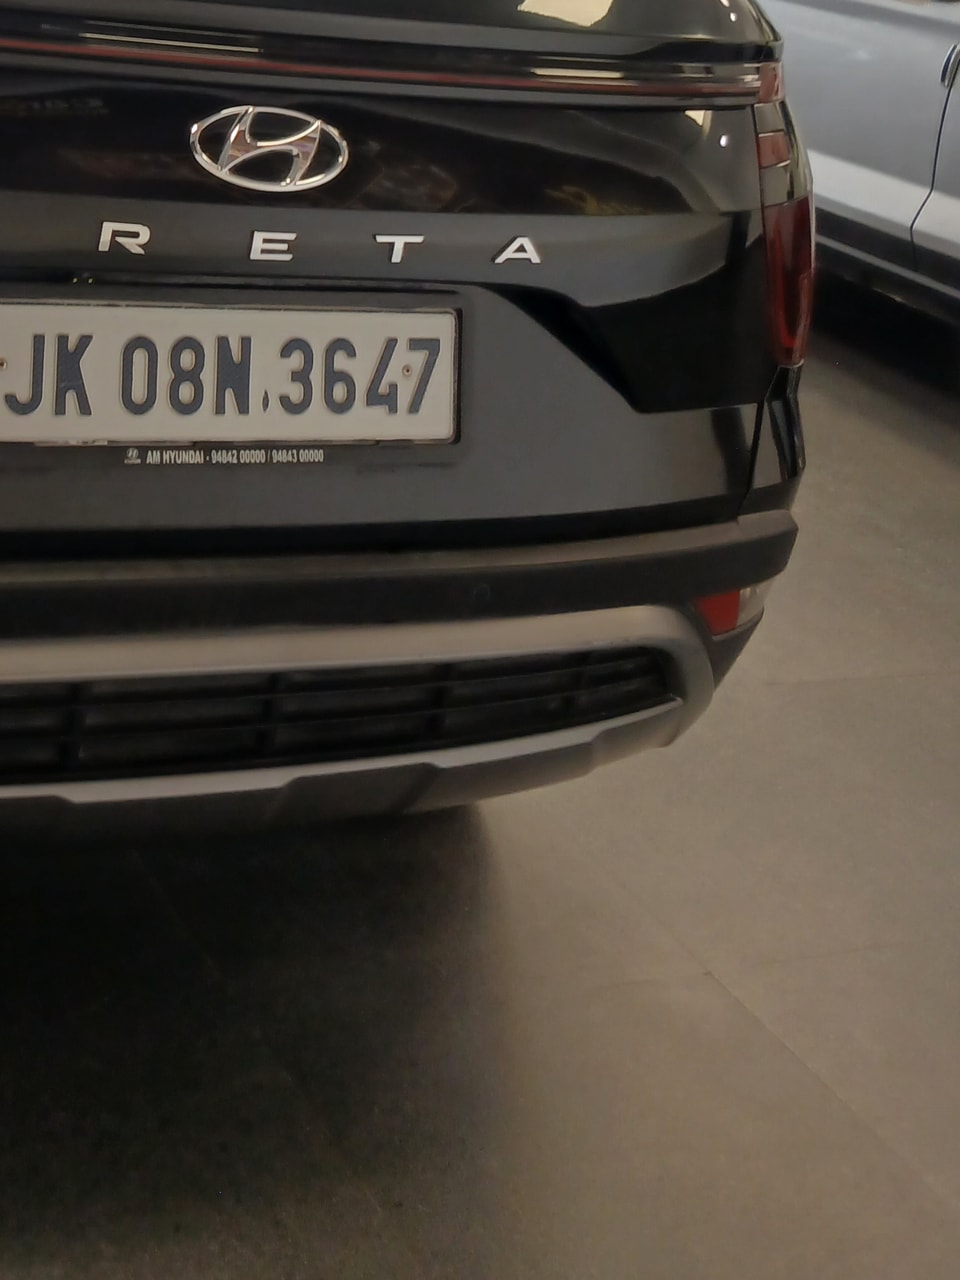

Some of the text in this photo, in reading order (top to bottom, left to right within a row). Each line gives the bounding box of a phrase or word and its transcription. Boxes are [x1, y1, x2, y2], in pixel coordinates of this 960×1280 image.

[146, 450, 161, 464] AM
[163, 449, 205, 464] HYUNDAI
[211, 449, 238, 463] 94842
[239, 449, 266, 463] 00000
[272, 449, 298, 463] 94843
